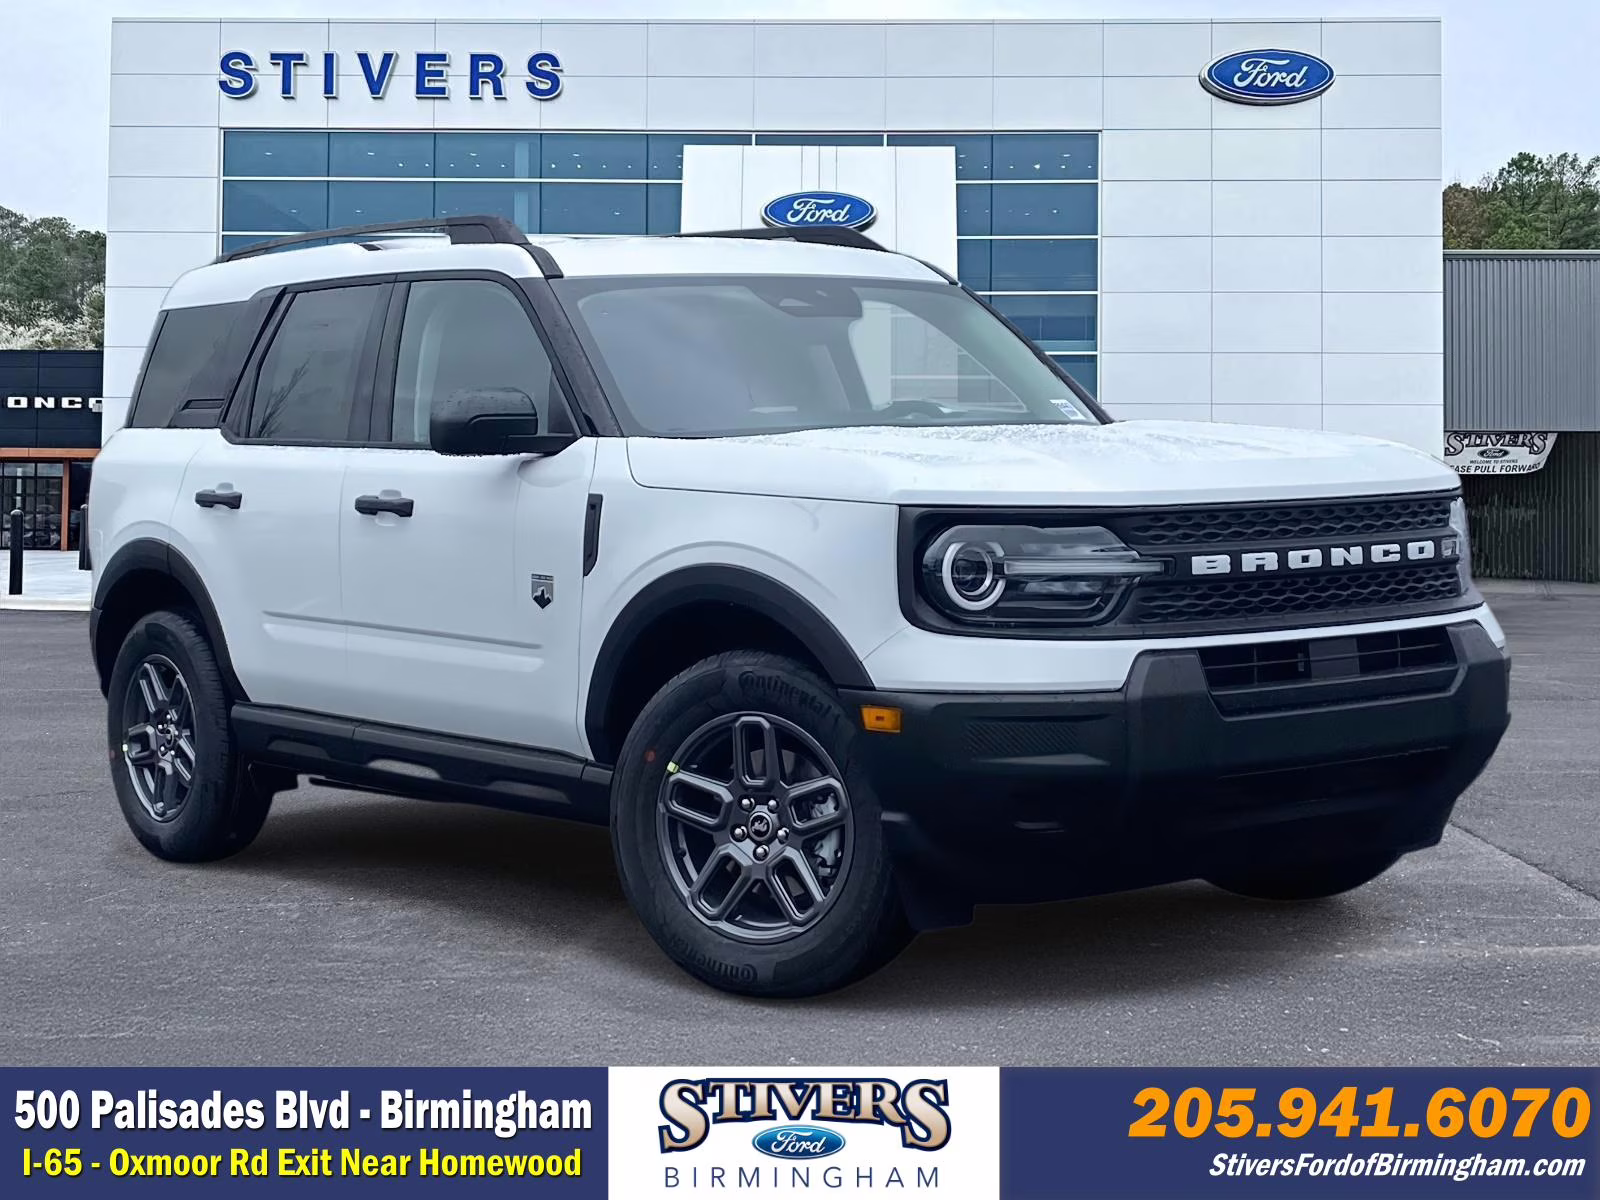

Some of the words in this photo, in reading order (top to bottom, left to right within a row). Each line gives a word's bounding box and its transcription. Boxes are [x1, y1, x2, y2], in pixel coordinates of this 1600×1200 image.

[218, 51, 564, 101] STIVERS
[1233, 58, 1308, 88] Ford
[787, 198, 851, 222] Ford
[1444, 432, 1548, 456] STIVERS
[1474, 465, 1497, 473] PULL
[1191, 540, 1435, 575] BRONCO
